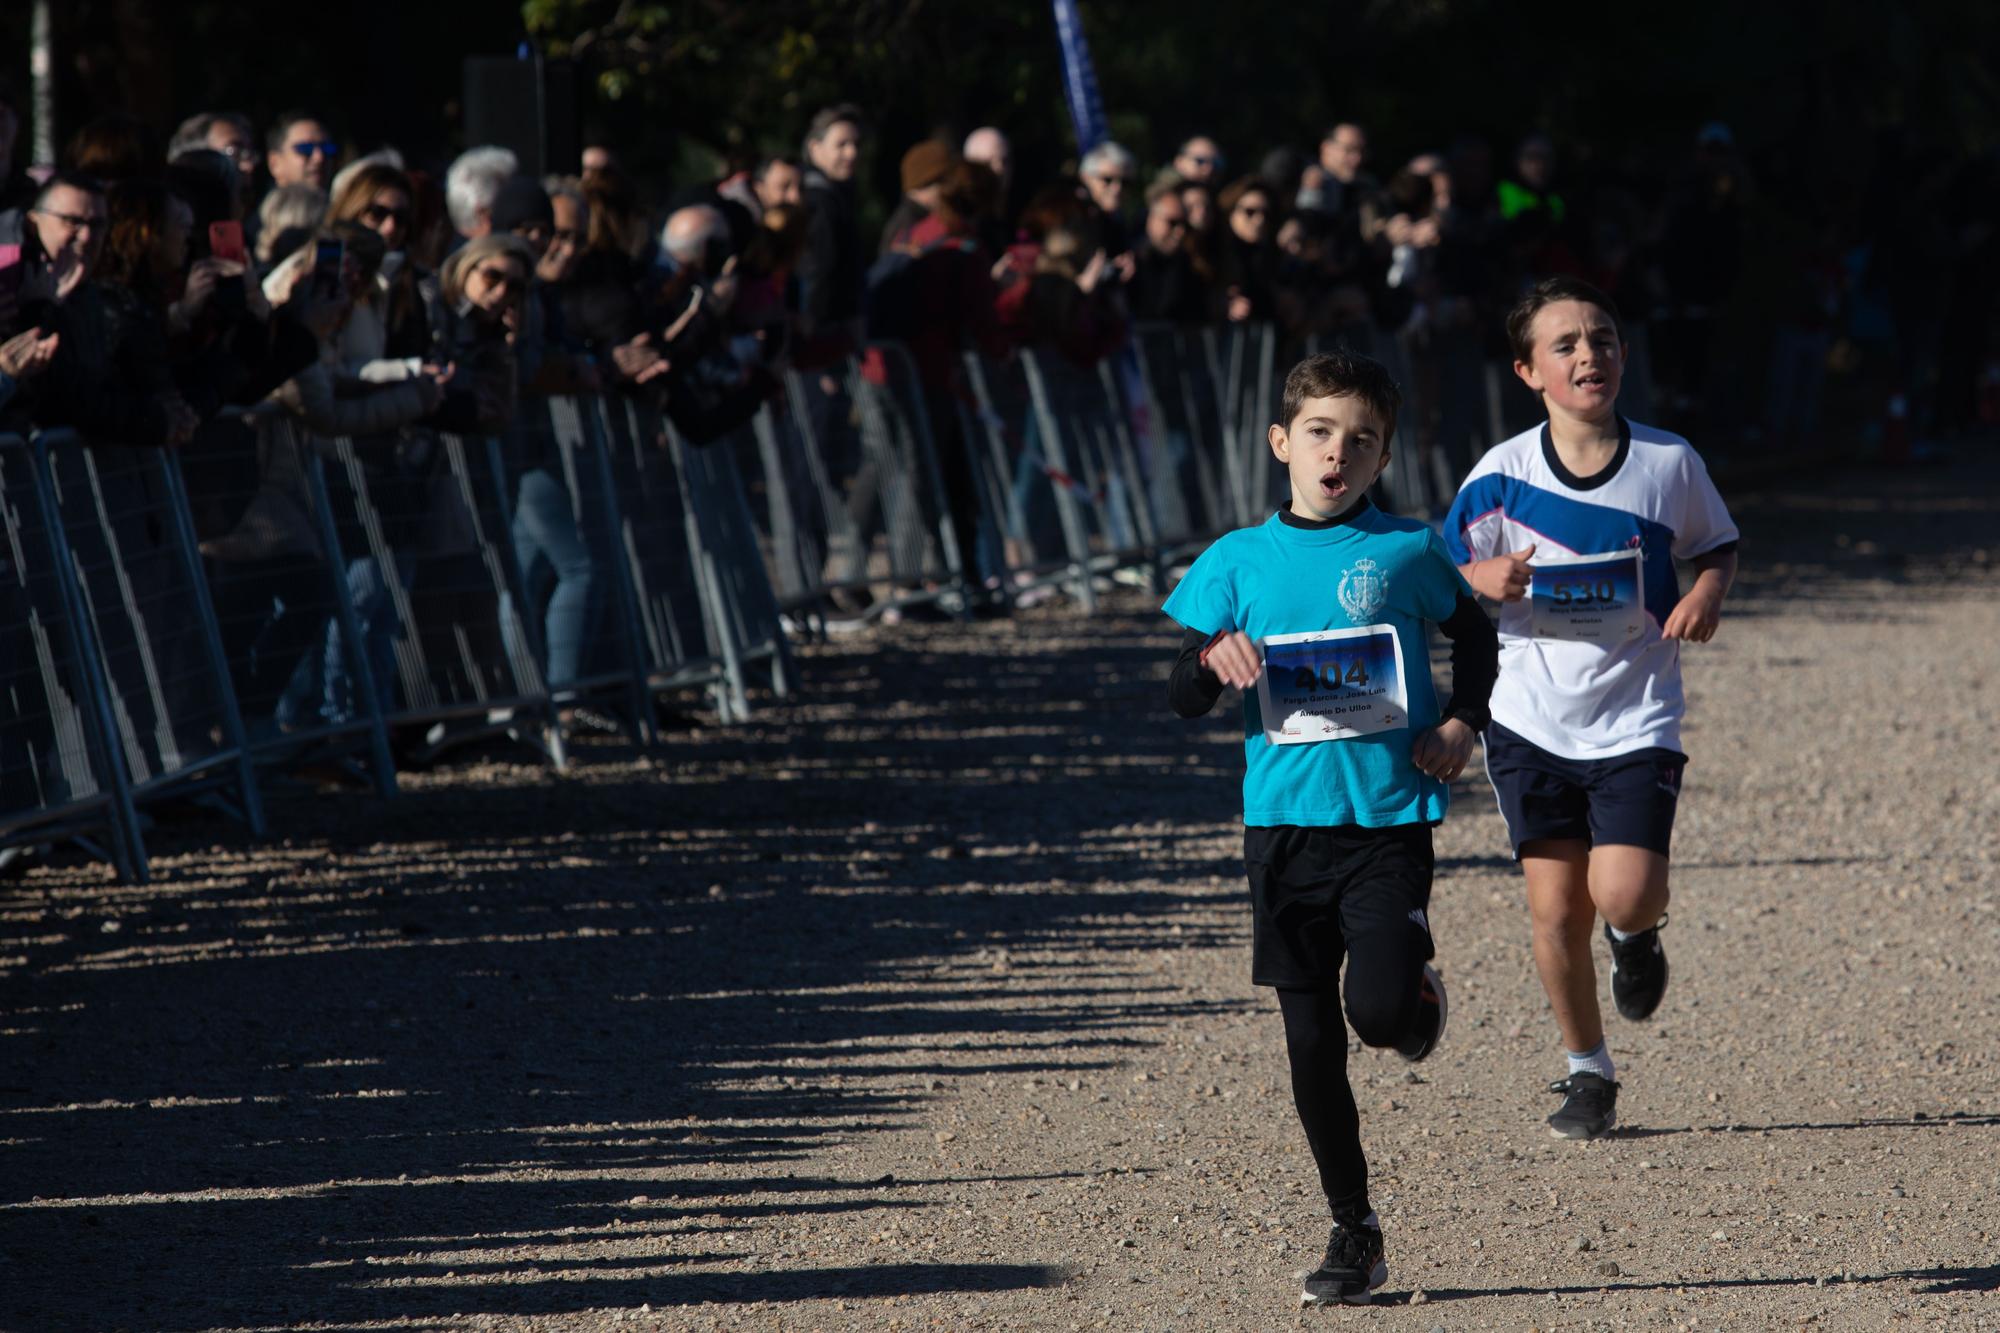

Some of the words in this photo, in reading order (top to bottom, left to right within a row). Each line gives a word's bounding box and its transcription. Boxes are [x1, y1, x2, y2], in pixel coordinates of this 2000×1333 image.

[1553, 579, 1614, 605] 530
[1296, 657, 1370, 692] 404
[1369, 687, 1386, 696] Luis
[1300, 708, 1332, 717] Antonio
[1349, 704, 1372, 713] Ulloa
